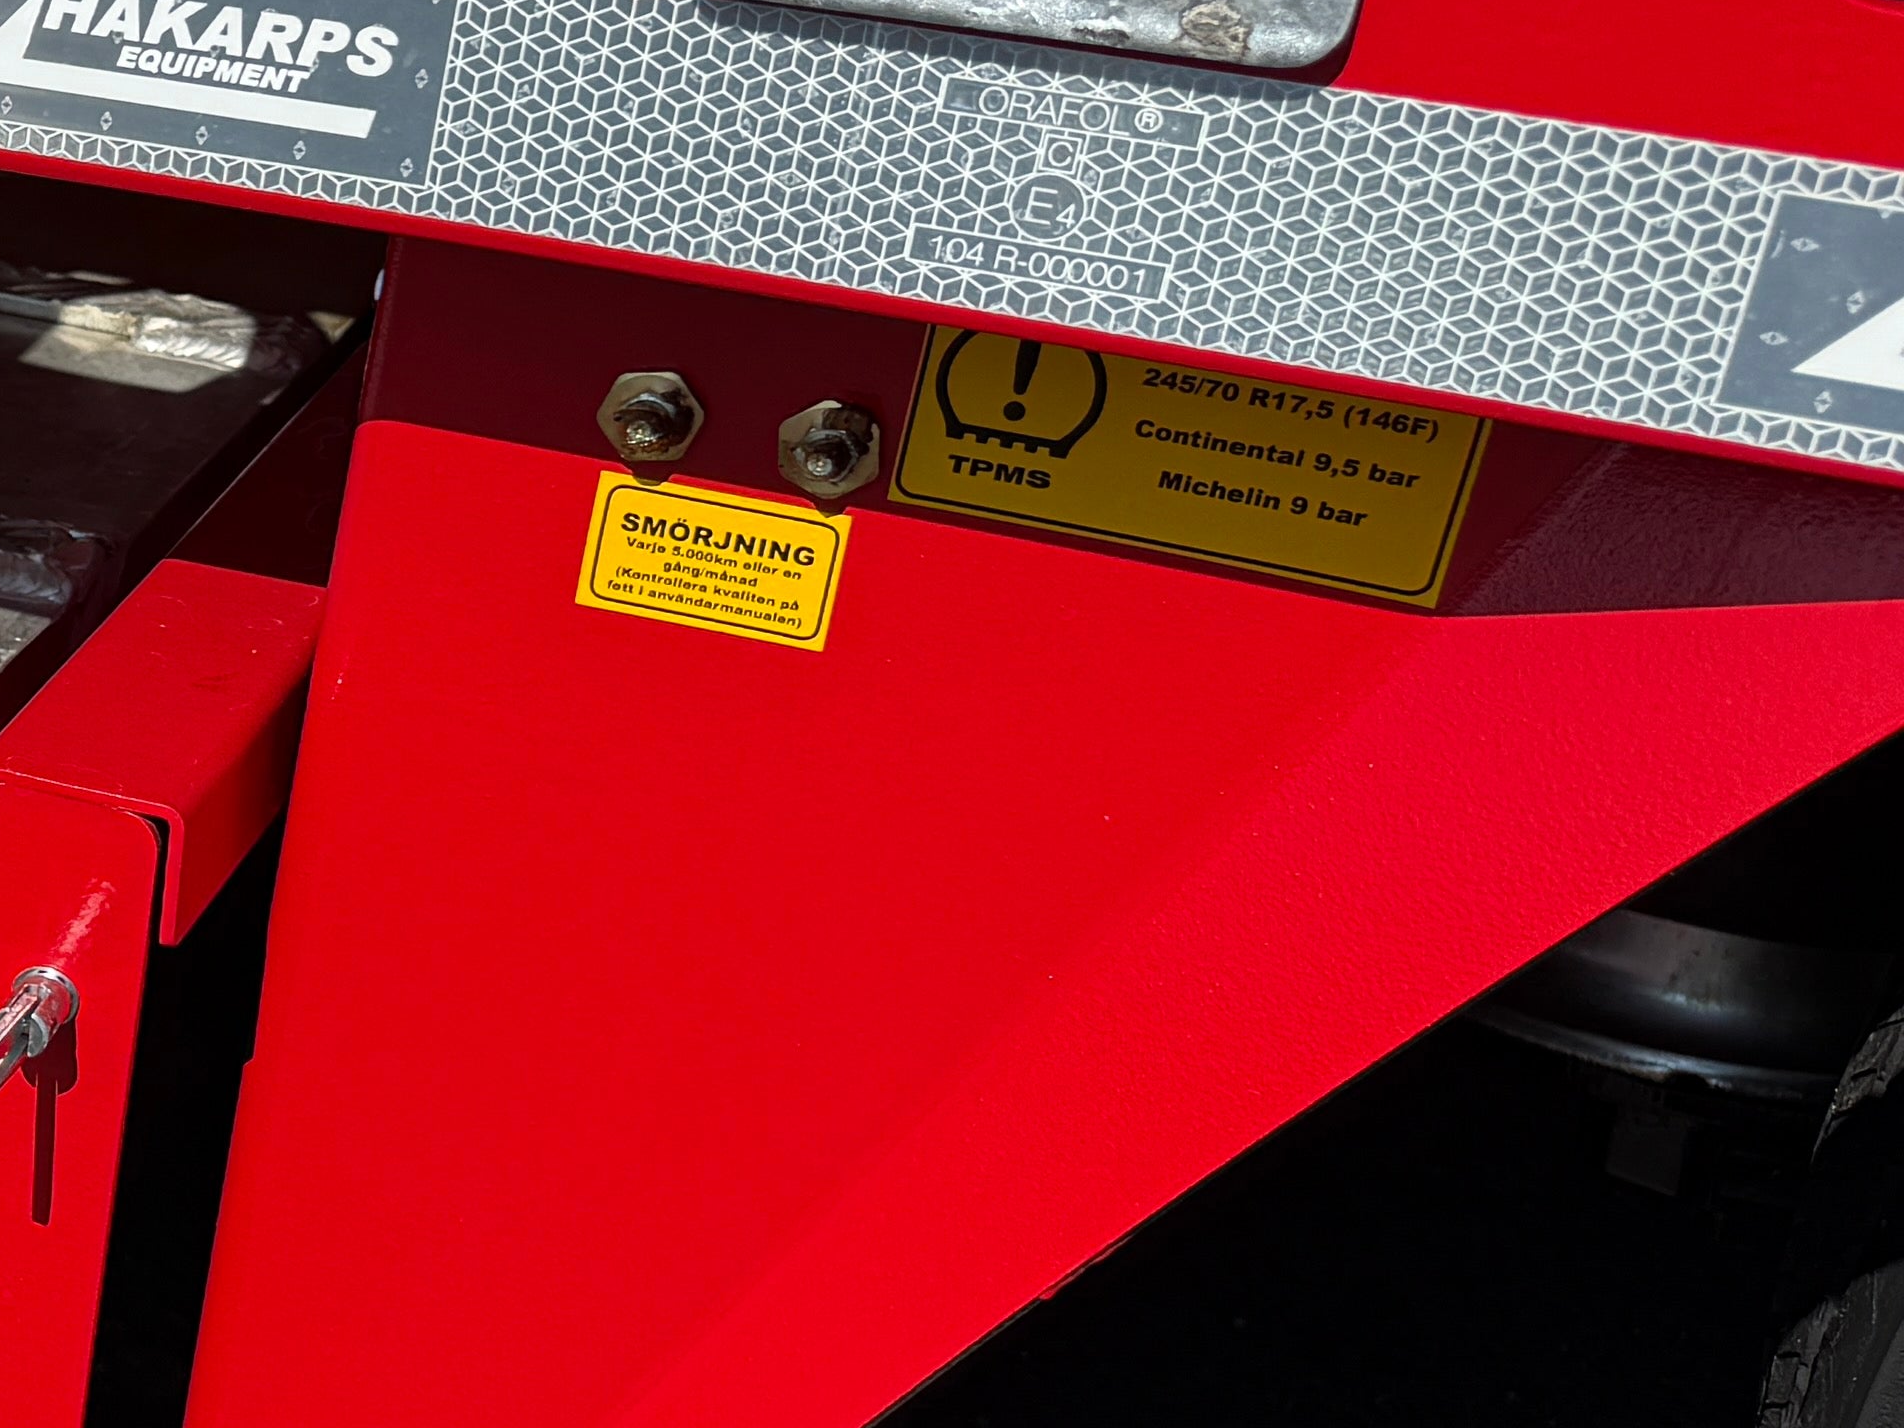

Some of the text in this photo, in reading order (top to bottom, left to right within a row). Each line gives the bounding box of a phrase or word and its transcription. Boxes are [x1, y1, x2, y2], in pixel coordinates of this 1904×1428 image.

[116, 46, 312, 93] EQUIPMENT
[1027, 186, 1075, 229] E4
[929, 235, 1147, 294] 104 R-000001
[1142, 367, 1440, 444] 245/70 R17,5 (146F)
[947, 454, 1052, 490] TPMS
[1134, 419, 1421, 490] Continental 9,5 bar
[1157, 470, 1369, 528] Michelin 9 bar
[621, 512, 815, 566] SMÖRJNING
[627, 537, 666, 555] Varje
[743, 560, 779, 576] eller
[783, 570, 802, 580] en
[607, 579, 634, 595] fett
[616, 566, 708, 594] (Kontrollera
[780, 598, 800, 613] på
